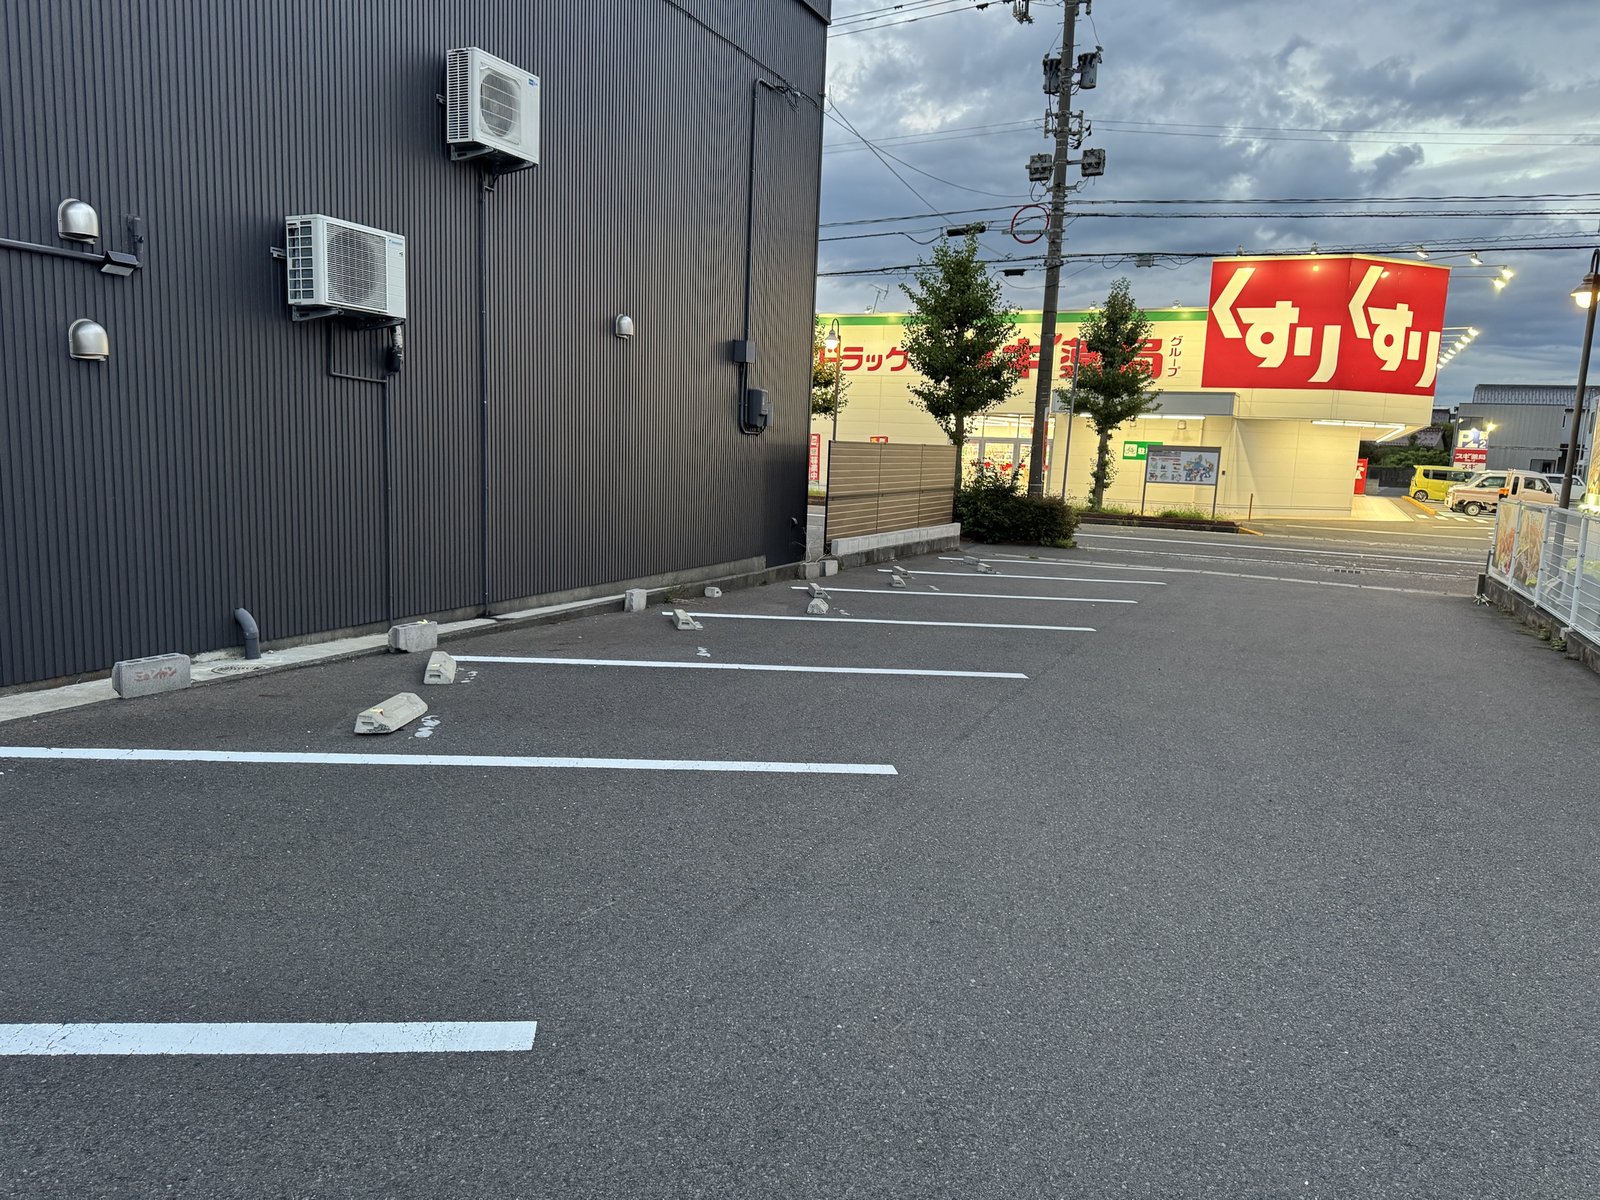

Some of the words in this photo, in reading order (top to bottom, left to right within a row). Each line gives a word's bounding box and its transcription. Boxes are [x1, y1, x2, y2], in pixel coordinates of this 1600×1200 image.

[1167, 335, 1184, 377] グループ
[1211, 267, 1342, 383] くすり
[1348, 265, 1442, 388] くすり
